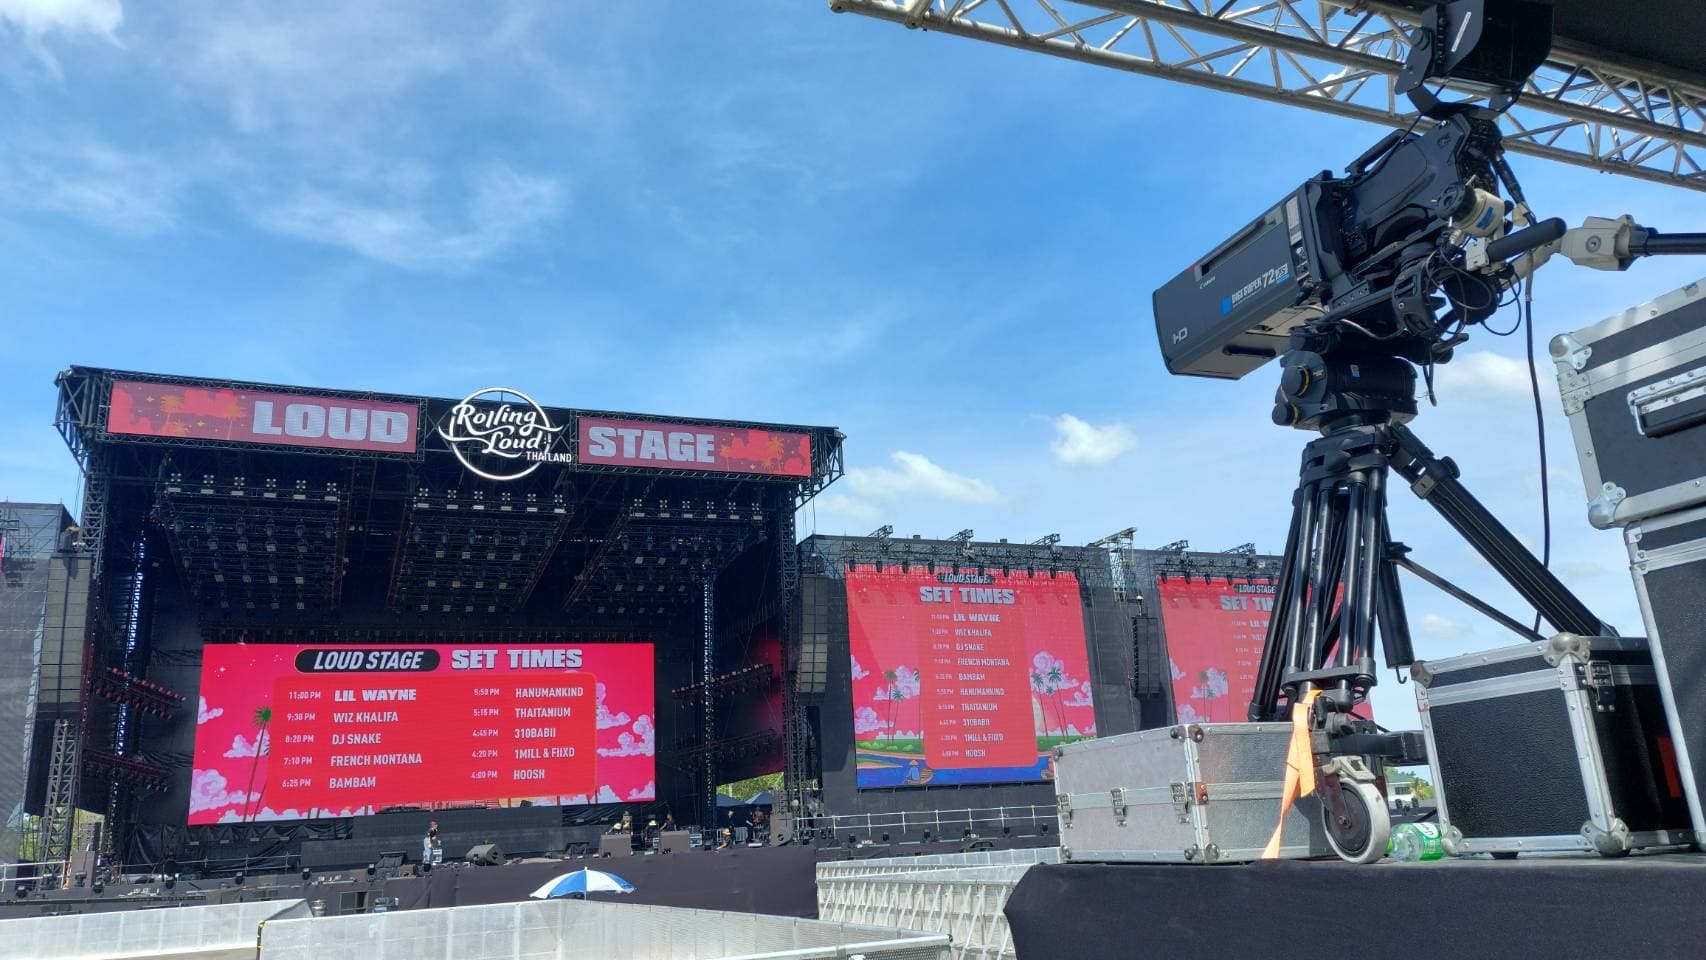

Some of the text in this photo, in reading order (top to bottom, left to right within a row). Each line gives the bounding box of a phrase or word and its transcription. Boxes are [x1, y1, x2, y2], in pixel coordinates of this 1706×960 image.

[1243, 276, 1262, 296] SUPER
[1262, 268, 1275, 289] 72
[1173, 327, 1188, 345] HD
[252, 399, 409, 444] LOUD
[452, 404, 561, 436] Rolling
[446, 428, 543, 458] Loud
[588, 426, 715, 463] STAGE
[525, 451, 572, 463] THAILAND
[944, 573, 988, 584] LOUD STAGE
[920, 586, 1015, 605] SET TIMES
[1239, 584, 1276, 594] LOUD STAGE
[1221, 595, 1248, 611] SET
[314, 651, 424, 670] LOUD STAGE
[451, 649, 583, 669] SET TIMES
[288, 689, 416, 702] 11:00 PM LIL WAYNE
[474, 688, 489, 696] 5:50
[515, 687, 584, 698] HANUMANKIND
[287, 711, 399, 723] 9:30 PM WIZ KHALIFA
[473, 707, 571, 718] 5:15 PM THAITANIUM
[285, 733, 382, 745] 8:20 PM DJ SNAKE
[472, 729, 487, 737] 4:45
[514, 728, 556, 739] 310BABII
[472, 750, 487, 758] 4:20
[515, 748, 541, 759] 1MILL
[543, 748, 550, 758] &
[551, 747, 575, 758] FIIXD
[283, 753, 422, 767] 7:10 PM FRENCH MONTANA
[471, 771, 486, 779] 4:00
[514, 769, 545, 780] HOOSH
[282, 776, 376, 789] 6:25 PM BAMBAM
